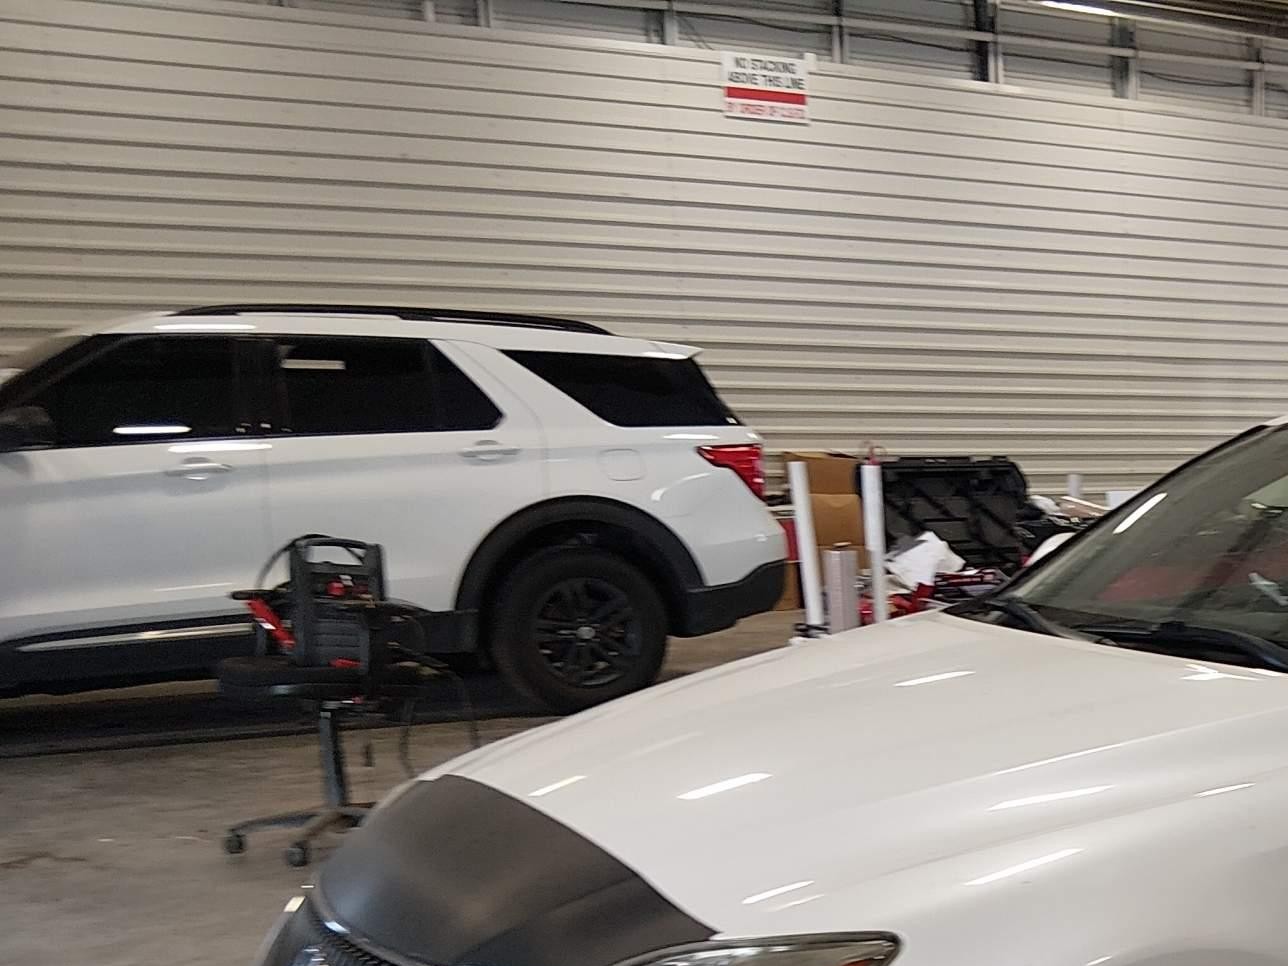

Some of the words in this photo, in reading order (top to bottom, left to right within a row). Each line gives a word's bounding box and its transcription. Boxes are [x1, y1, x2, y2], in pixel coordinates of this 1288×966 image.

[750, 58, 797, 74] STACKING
[728, 72, 759, 85] ABOVE
[761, 74, 784, 88] THIS
[784, 77, 806, 90] LINE
